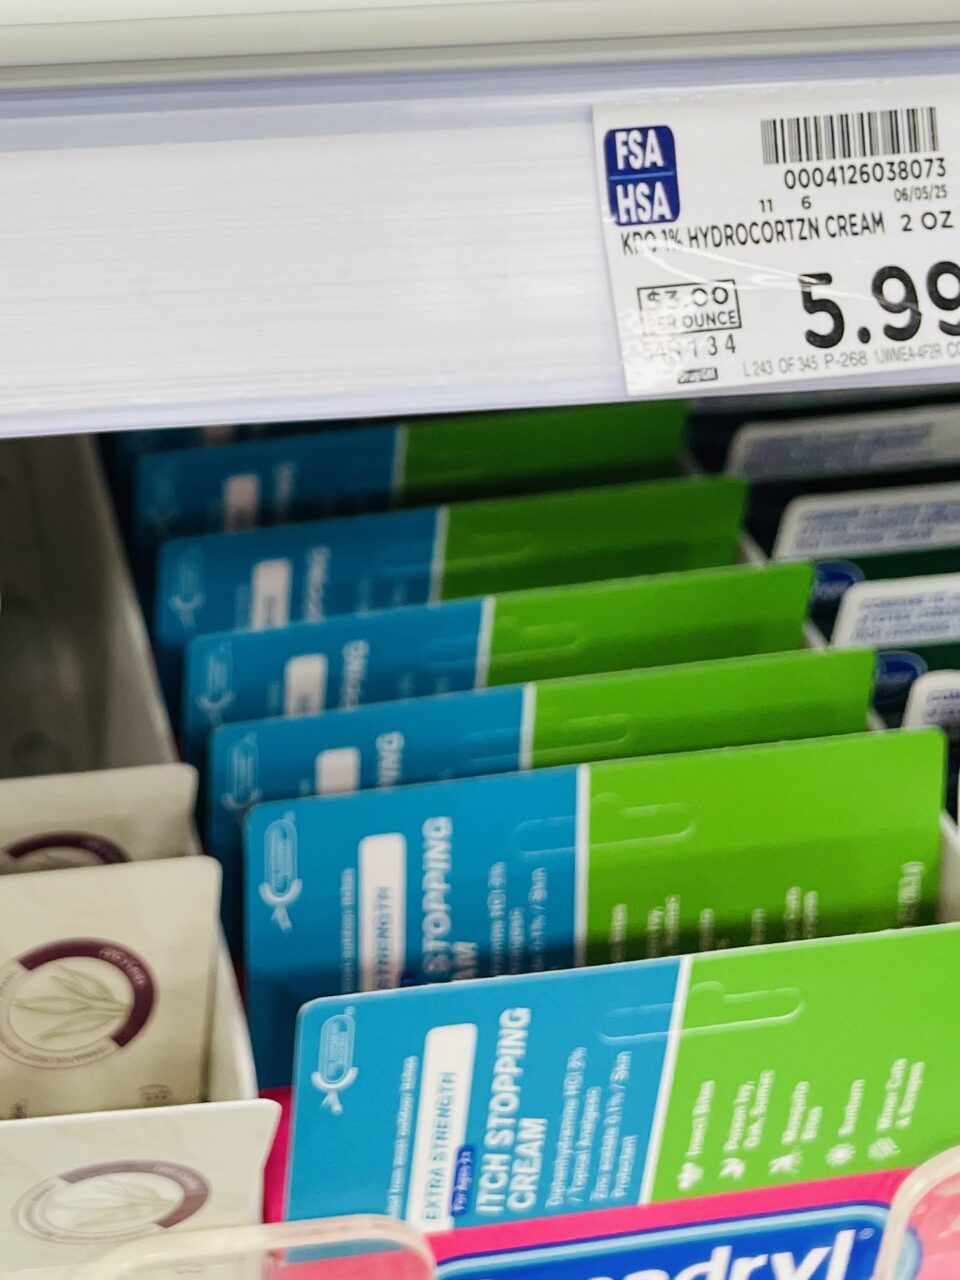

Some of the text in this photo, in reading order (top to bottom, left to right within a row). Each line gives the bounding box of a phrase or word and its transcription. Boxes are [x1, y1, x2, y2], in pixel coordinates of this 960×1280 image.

[615, 128, 664, 170] FSA
[785, 157, 947, 189] 0004126038073
[616, 181, 672, 224] HSA
[759, 195, 812, 214] 11 6
[687, 217, 820, 251] HYDROCORTZN
[826, 211, 886, 239] CREAM
[901, 214, 912, 232] 2
[921, 210, 953, 230] OZ
[682, 310, 737, 329] OUNCE
[798, 261, 960, 349] 5.99
[706, 335, 718, 356] 3
[725, 333, 736, 354] 4
[824, 351, 868, 369] P-268
[476, 1007, 531, 1213] ITCH STOPPING
[511, 1118, 547, 1210] CREAM
